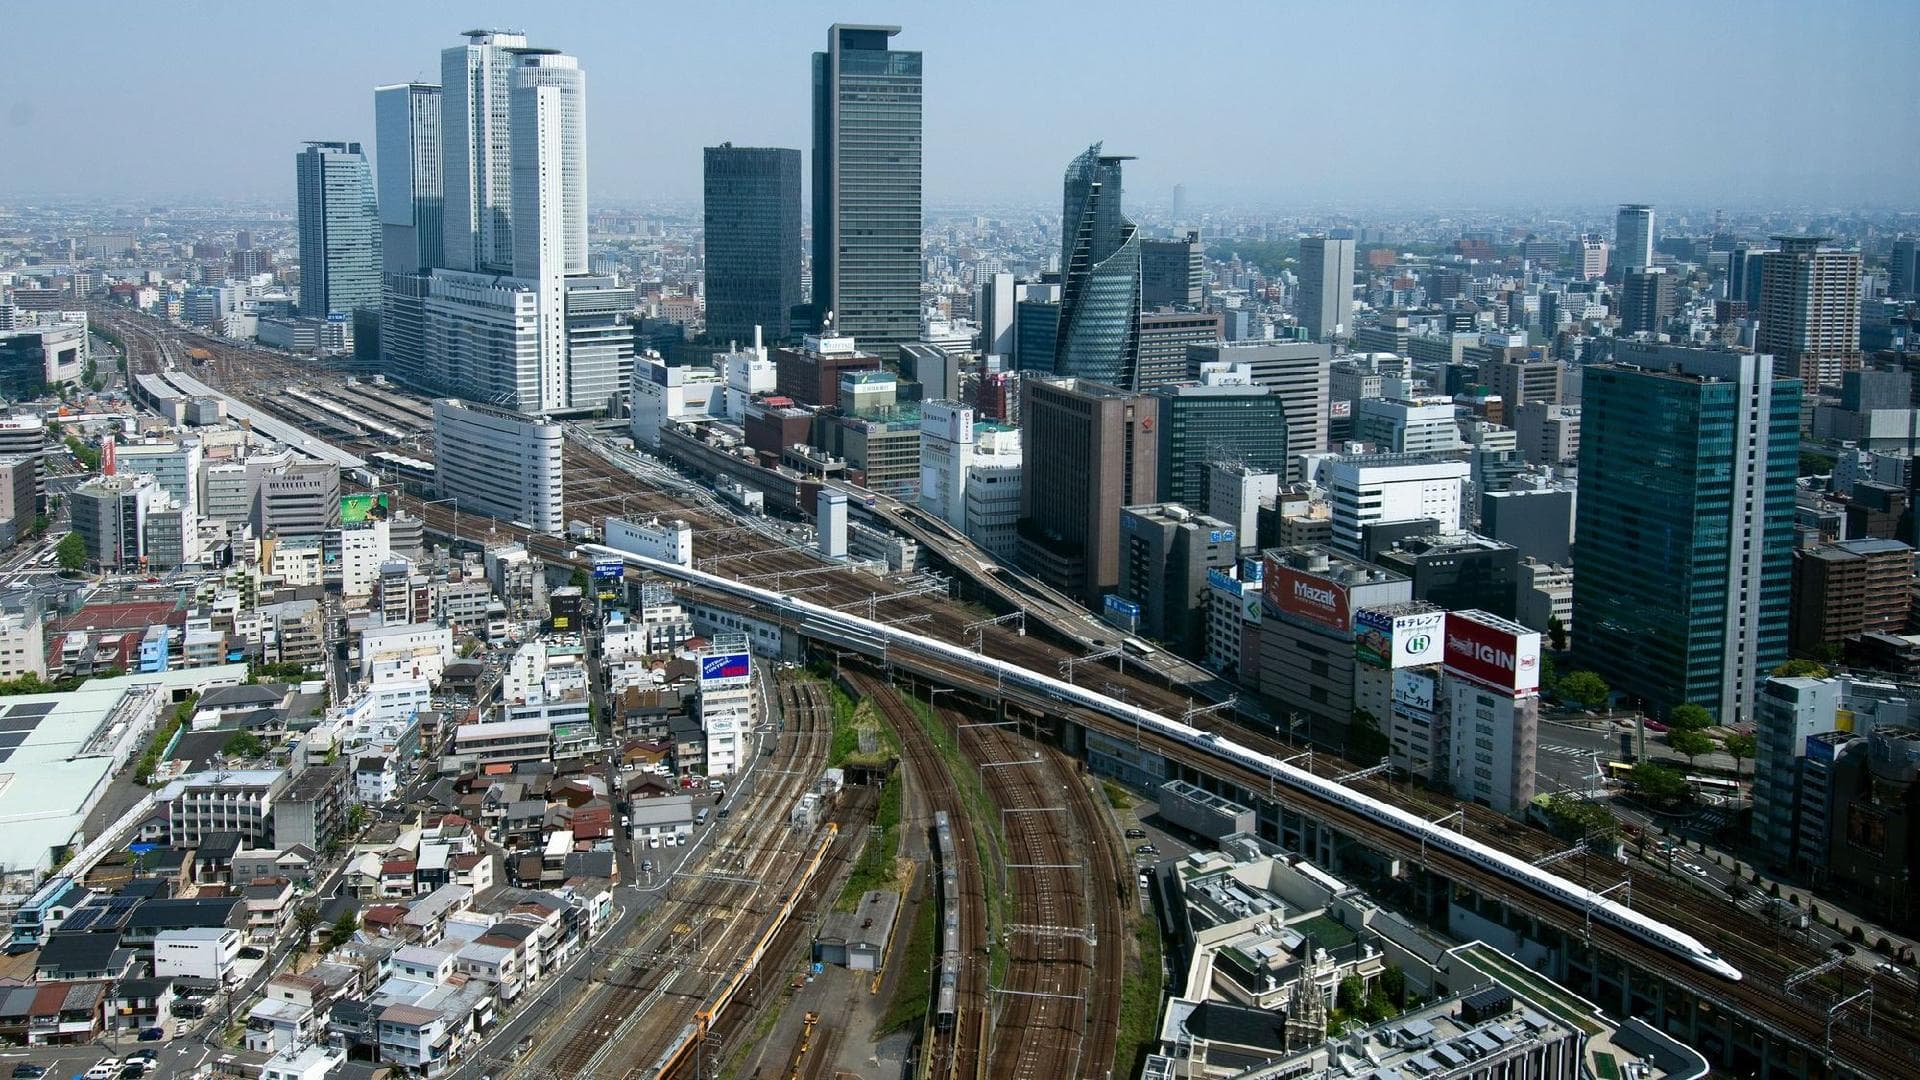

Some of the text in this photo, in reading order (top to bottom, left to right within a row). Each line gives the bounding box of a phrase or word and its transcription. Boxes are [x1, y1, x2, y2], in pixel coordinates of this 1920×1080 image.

[1294, 580, 1336, 607] Mazak
[1403, 691, 1430, 707] トーカイ
